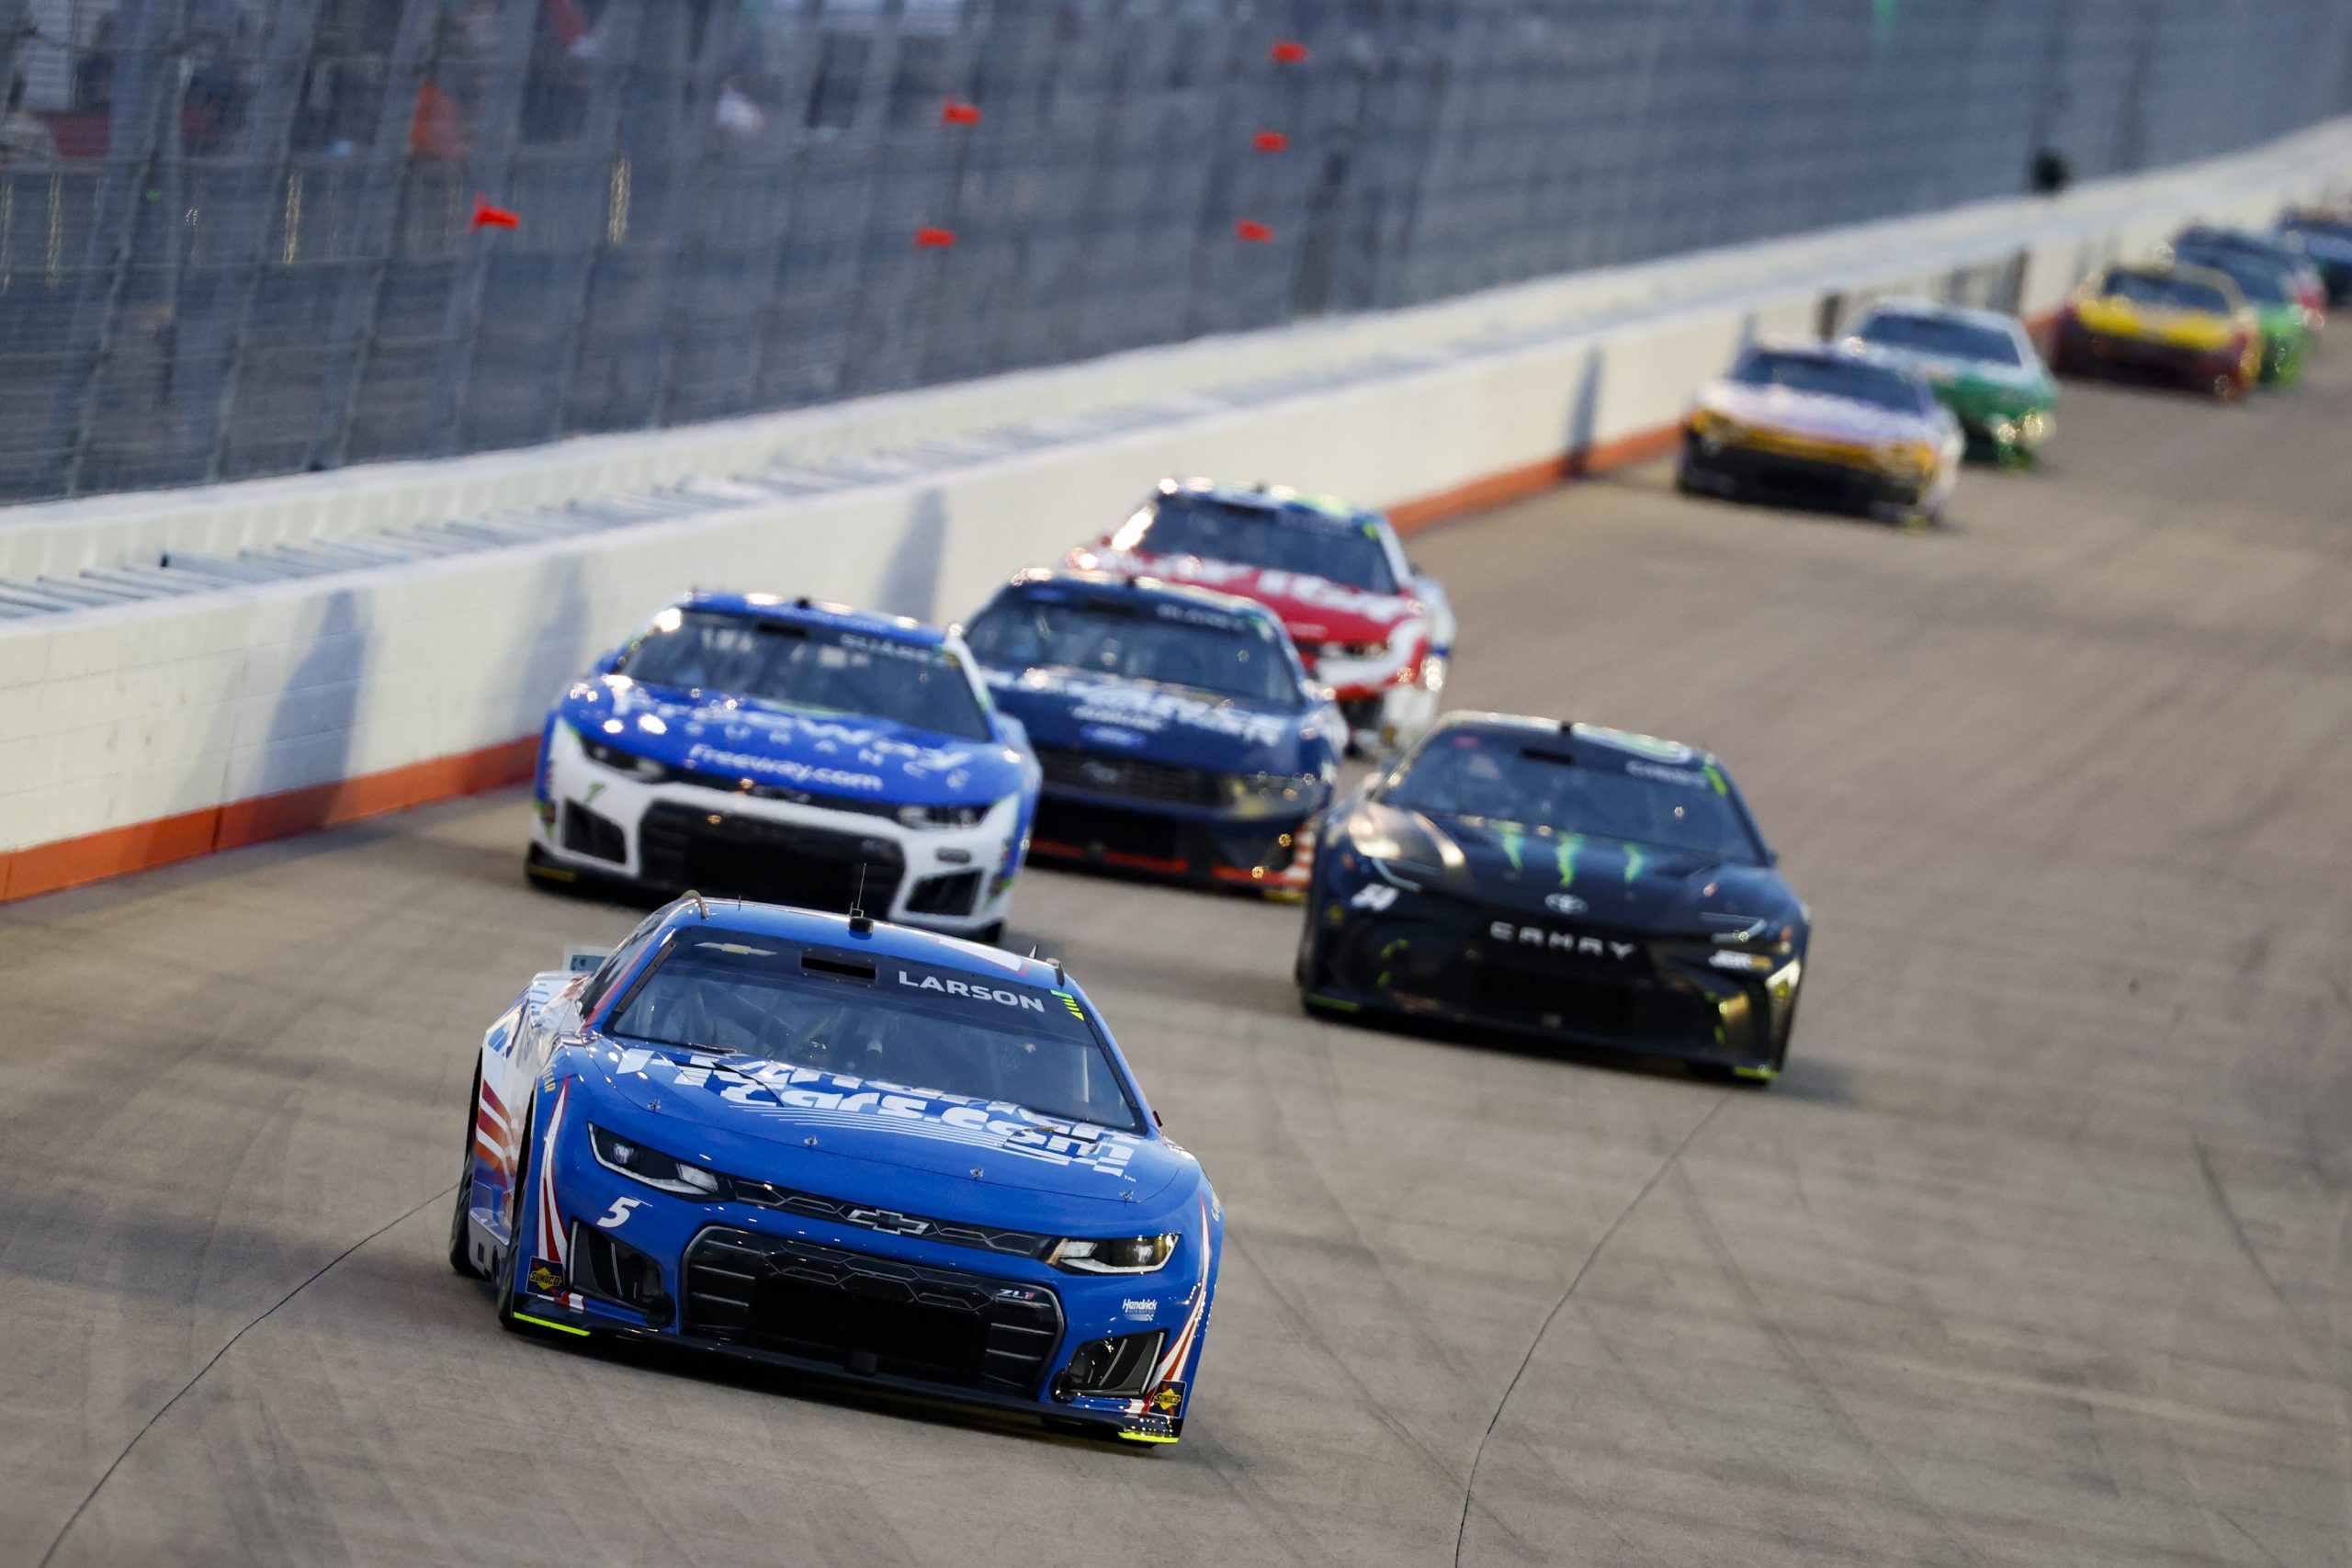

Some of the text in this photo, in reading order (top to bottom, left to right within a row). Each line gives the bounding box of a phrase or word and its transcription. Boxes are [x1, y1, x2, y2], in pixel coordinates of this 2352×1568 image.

[898, 970, 1046, 1013] LARSON
[596, 1196, 641, 1229] 5
[529, 1271, 563, 1286] SUNOCO
[1122, 1298, 1159, 1314] Hendrick
[1155, 1392, 1181, 1406] SUNOCO
